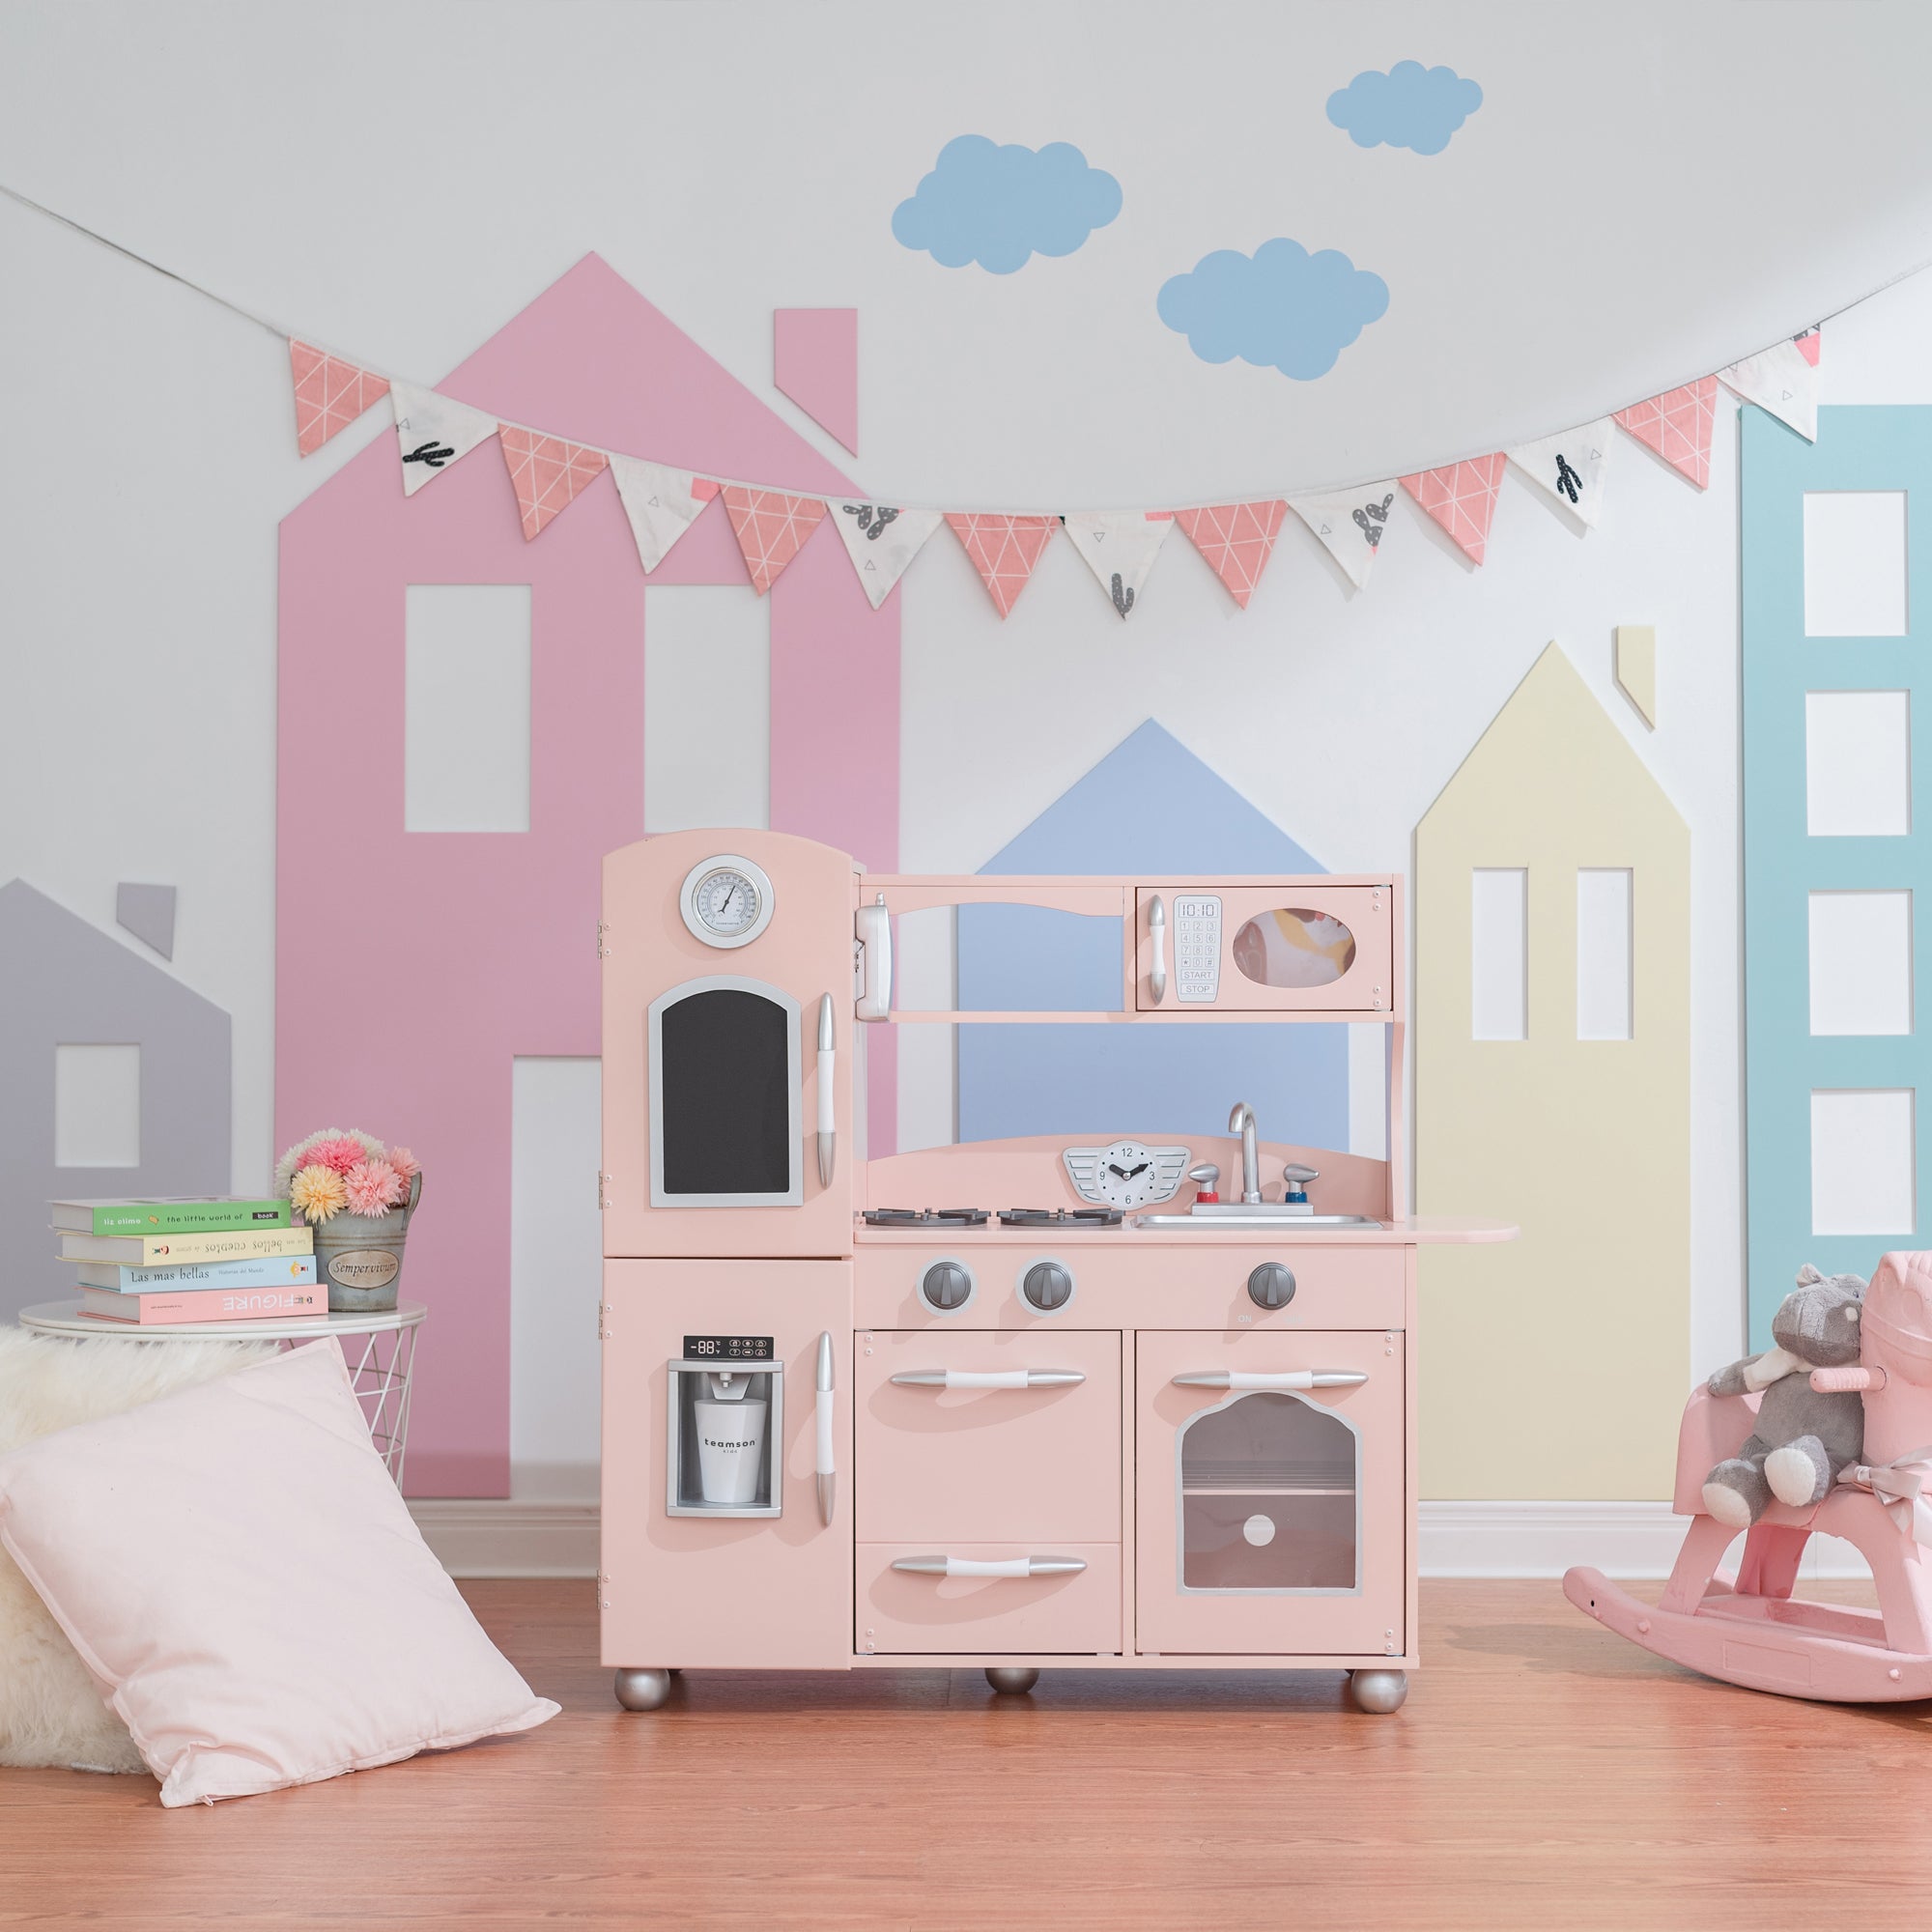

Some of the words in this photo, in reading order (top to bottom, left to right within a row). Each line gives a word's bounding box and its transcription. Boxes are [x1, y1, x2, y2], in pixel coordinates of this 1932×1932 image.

[1182, 904, 1214, 917] 10:10
[1121, 1148, 1133, 1157] 12
[1099, 1171, 1106, 1180] 9
[1149, 1171, 1155, 1180] 3
[1124, 1194, 1131, 1205] 6
[204, 1241, 246, 1254] cuentos
[252, 1239, 283, 1252] bellos
[130, 1271, 149, 1283] Las
[154, 1271, 175, 1281] mas
[180, 1267, 211, 1280] bellas
[222, 1293, 295, 1312] FIGURE
[1236, 1314, 1252, 1322] ON
[704, 1437, 755, 1448] teamson
